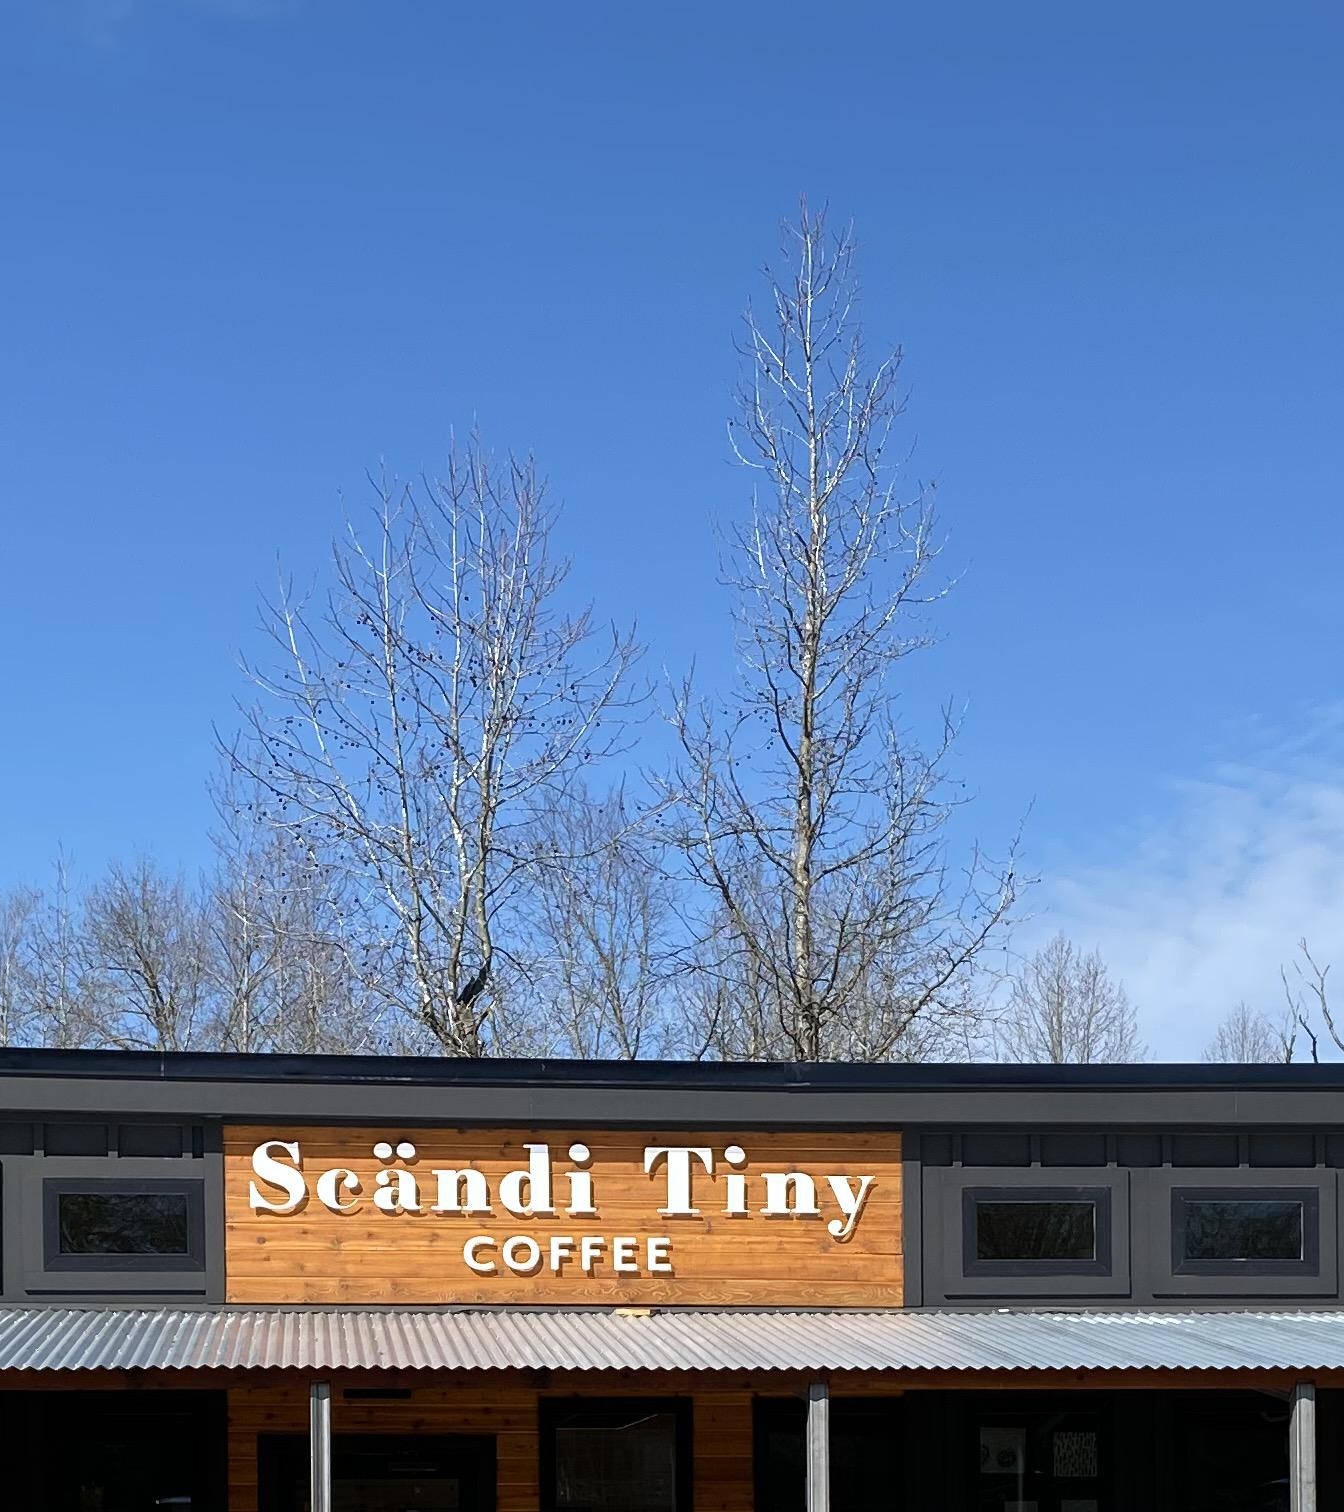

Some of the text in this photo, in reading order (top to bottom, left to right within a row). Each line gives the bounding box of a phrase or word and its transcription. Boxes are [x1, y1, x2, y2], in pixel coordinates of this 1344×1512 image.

[248, 1140, 875, 1238] Scändi Tiny
[463, 1235, 673, 1273] COFFEE
